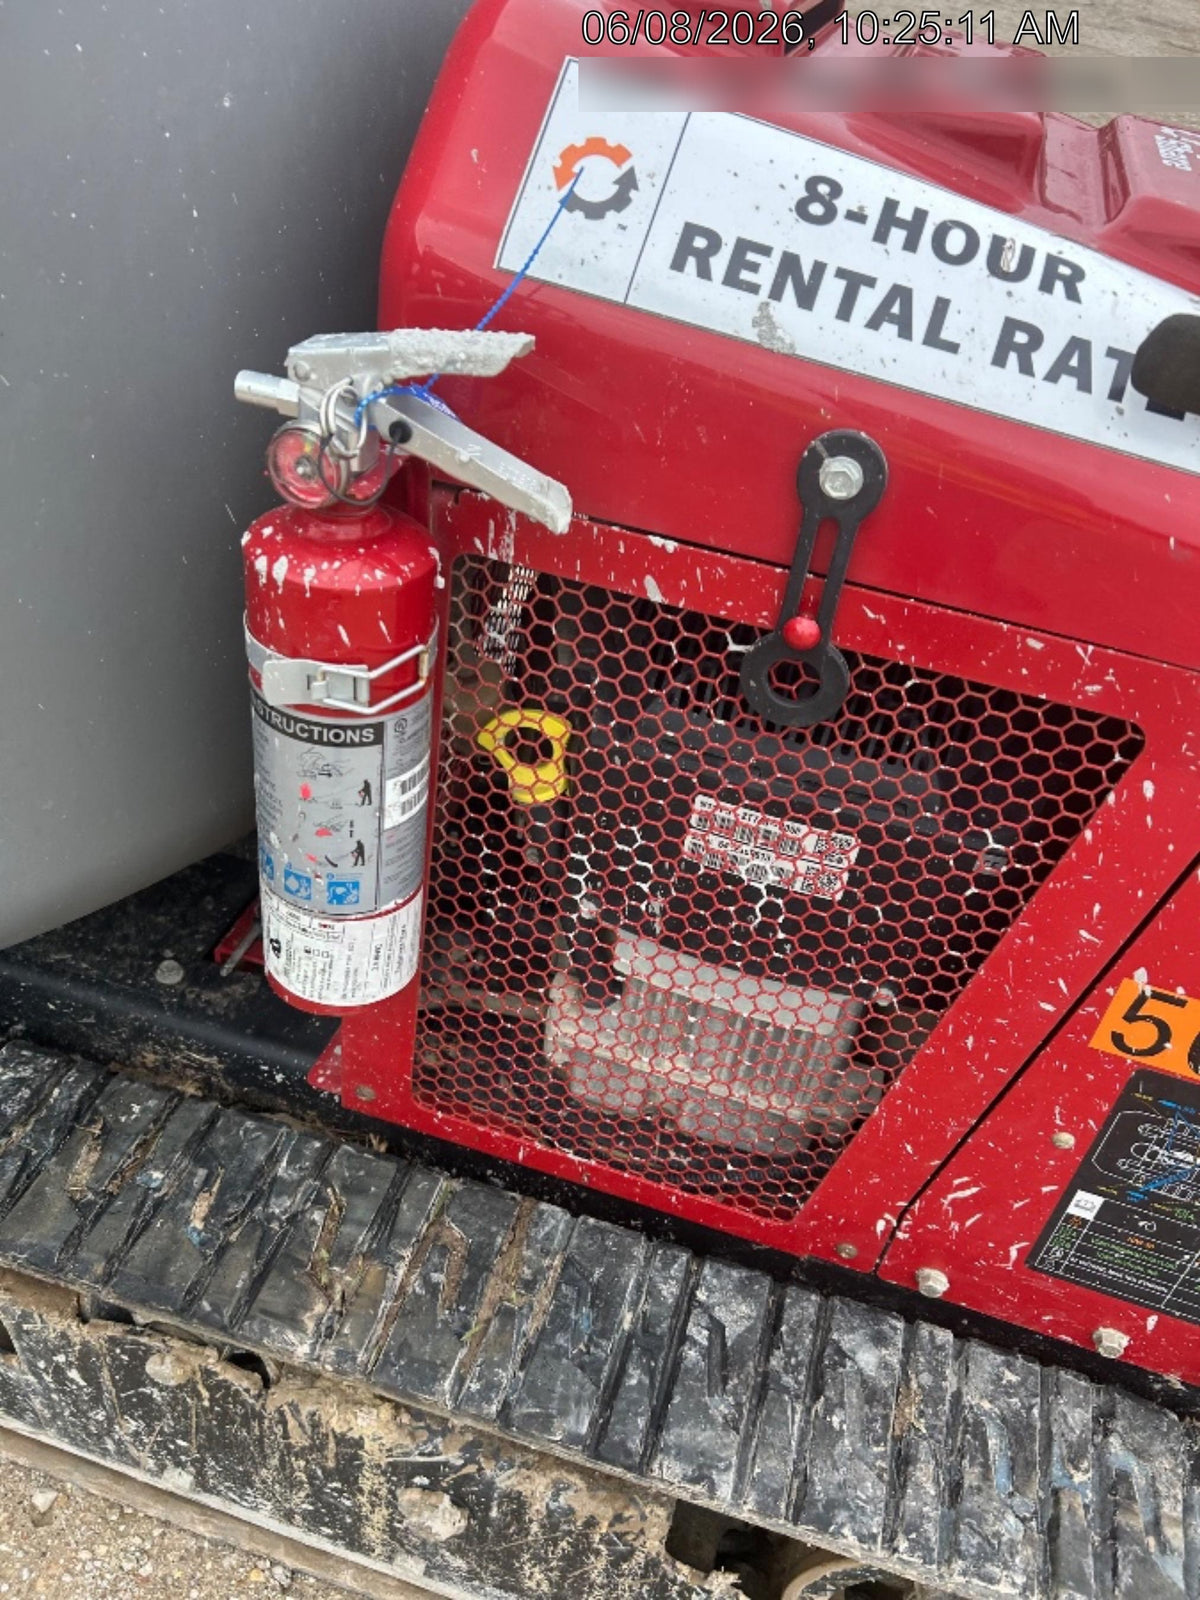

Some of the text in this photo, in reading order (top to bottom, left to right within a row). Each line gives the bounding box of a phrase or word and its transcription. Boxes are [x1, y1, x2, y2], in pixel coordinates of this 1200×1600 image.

[668, 221, 1137, 404] RENTAL RAT
[794, 174, 1087, 304] 8-HOUR
